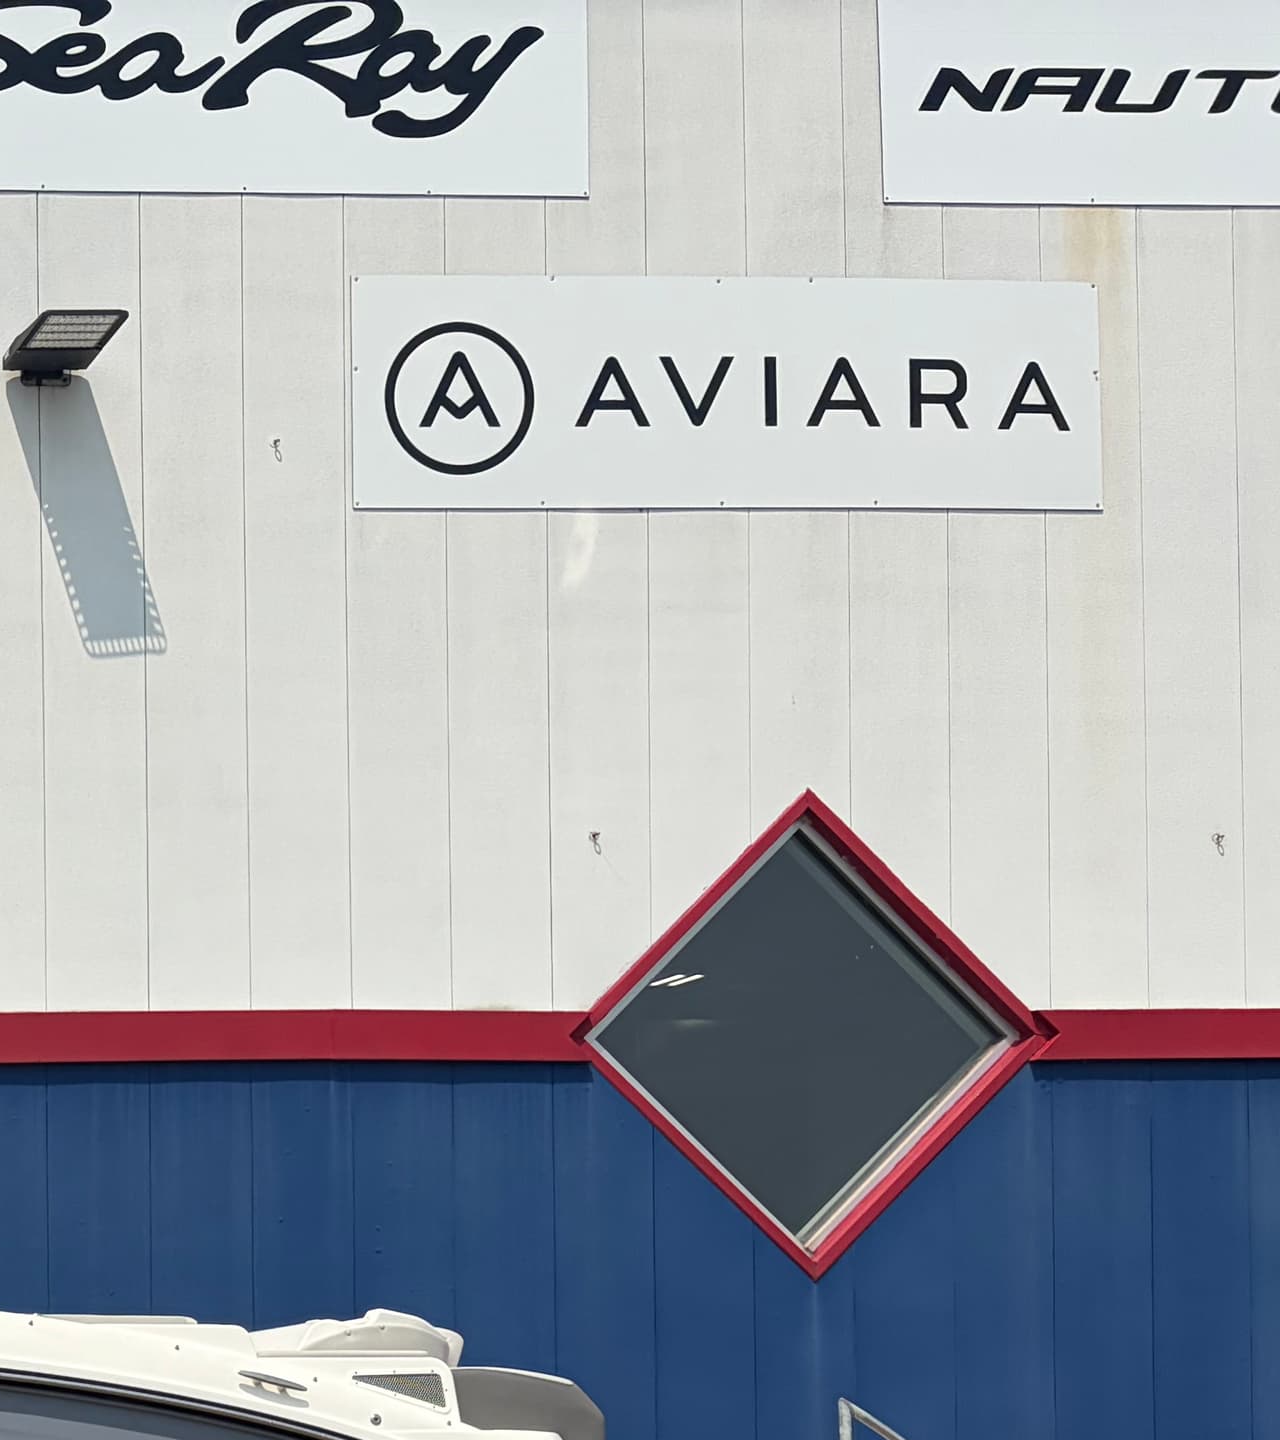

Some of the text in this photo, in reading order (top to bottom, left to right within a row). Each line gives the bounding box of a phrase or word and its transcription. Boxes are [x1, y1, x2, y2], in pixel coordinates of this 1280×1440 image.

[201, 0, 545, 139] Ray
[918, 67, 1280, 114] NAUT
[575, 356, 1071, 432] AVIARA
